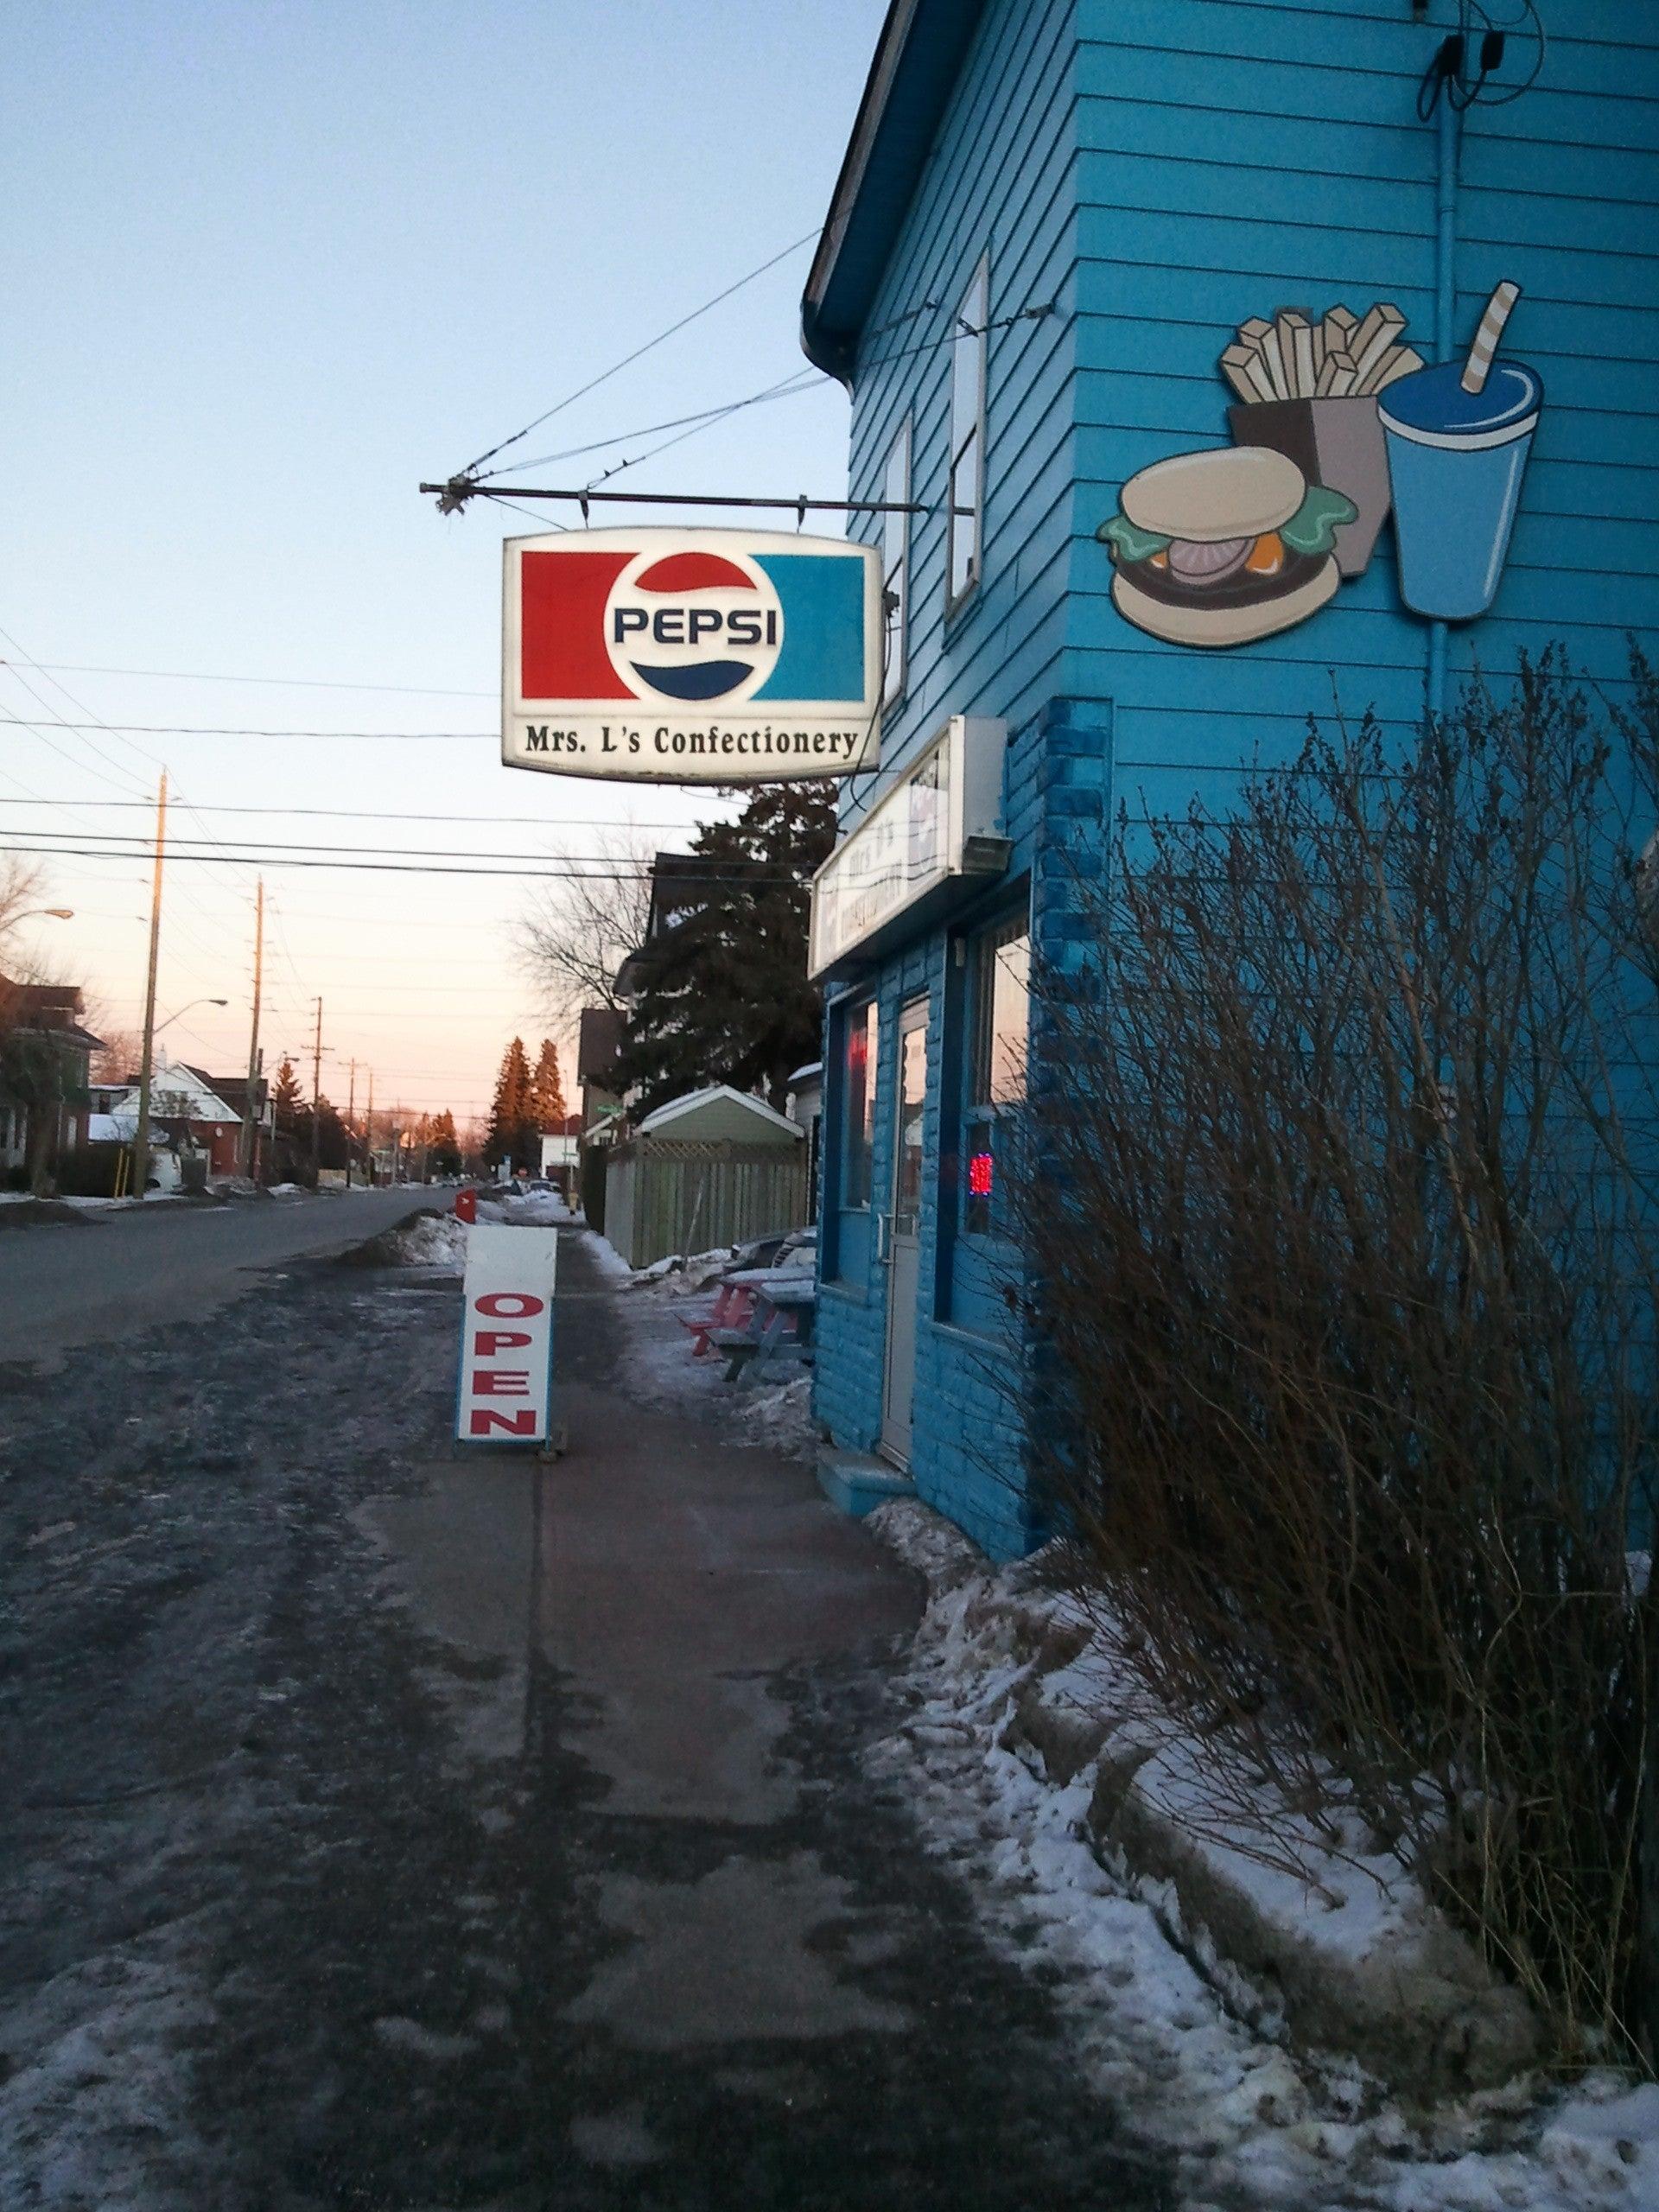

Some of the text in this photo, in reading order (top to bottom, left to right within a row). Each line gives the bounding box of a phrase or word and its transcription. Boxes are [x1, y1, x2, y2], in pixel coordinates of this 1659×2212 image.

[613, 607, 777, 645] PEPSI
[525, 725, 859, 760] Mrs. L's Confectionery
[470, 1293, 544, 1435] OPEN
